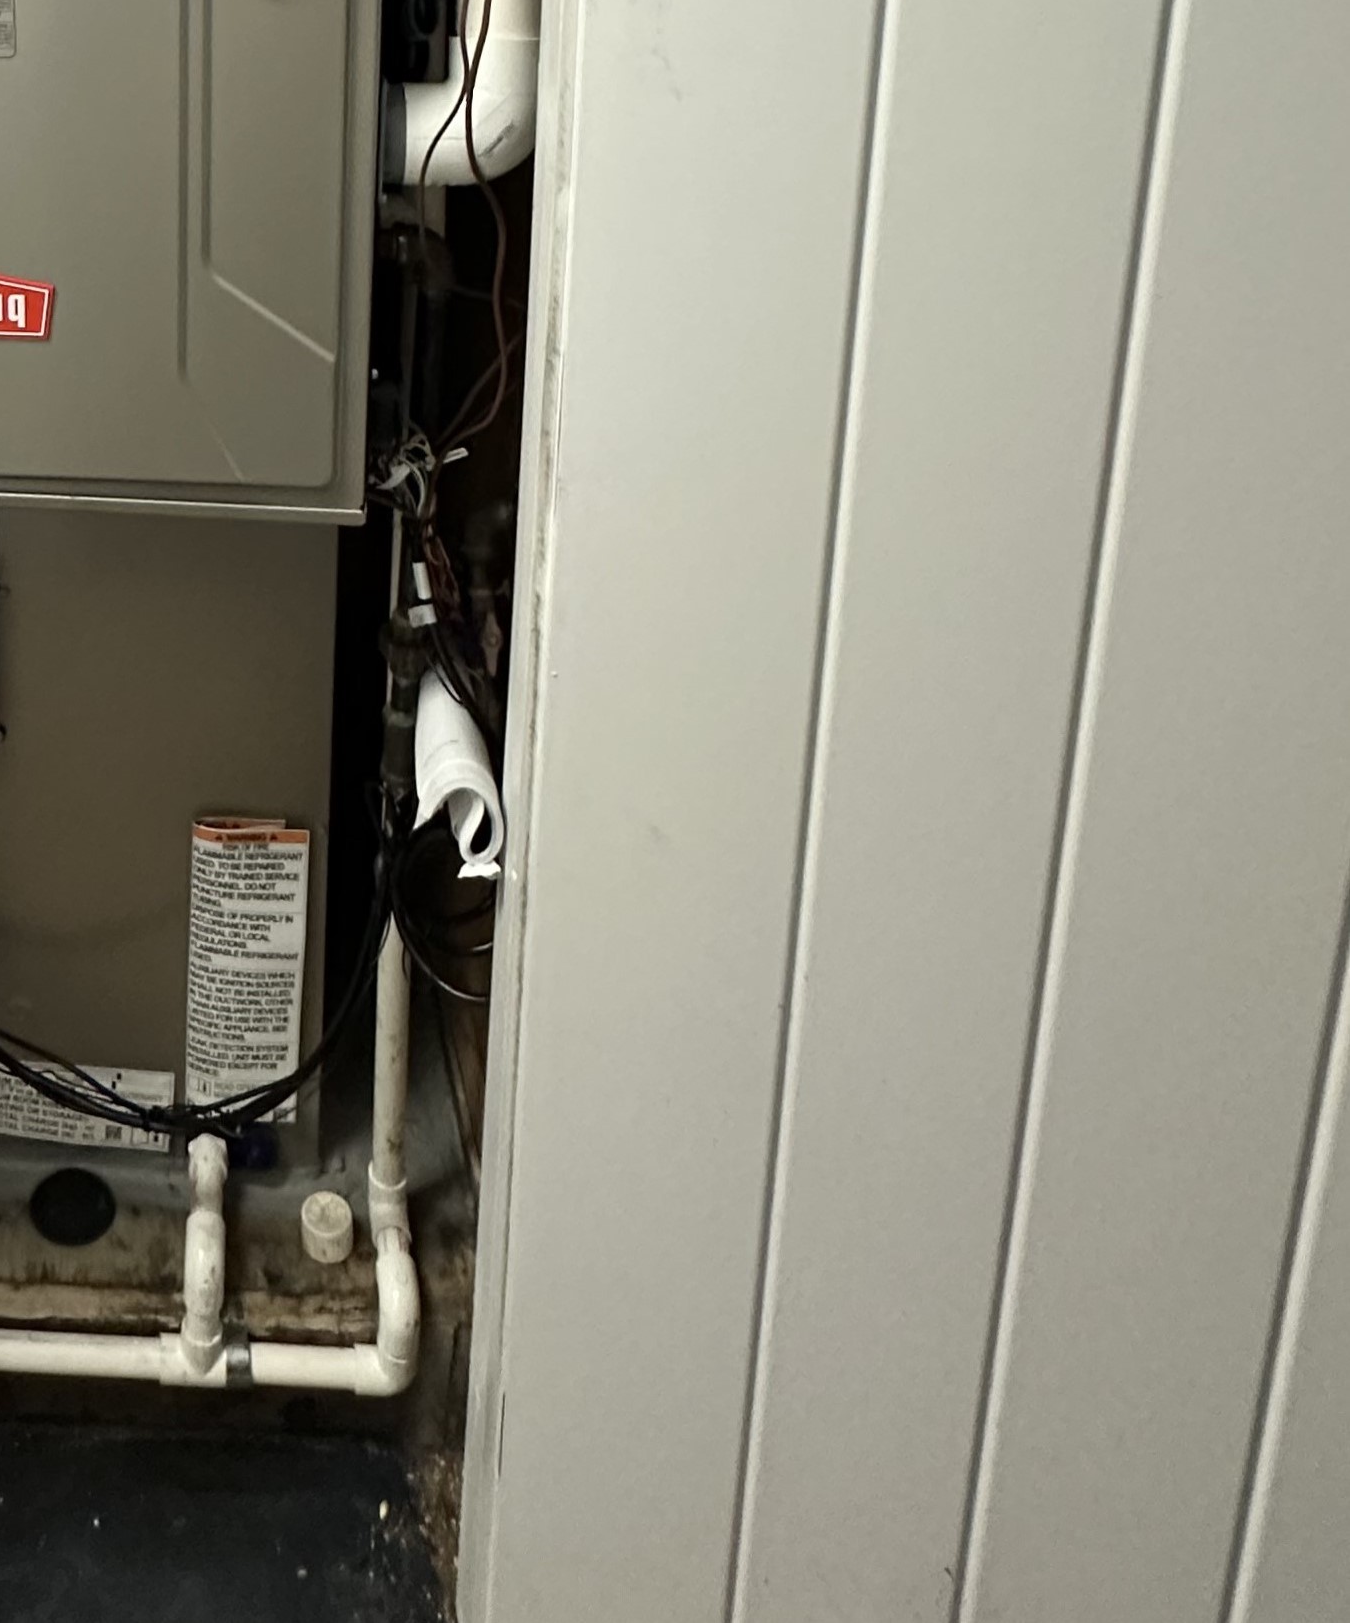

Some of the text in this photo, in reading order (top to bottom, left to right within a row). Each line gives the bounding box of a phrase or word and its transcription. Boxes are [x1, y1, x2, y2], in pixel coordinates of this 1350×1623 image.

[245, 853, 303, 861] REFRIGERANT
[243, 863, 285, 871] REPAIRED
[227, 872, 263, 881] TRAINED
[265, 873, 300, 881] SERVICE
[259, 882, 277, 891] NOT
[237, 892, 296, 901] REFRIGERANT
[243, 932, 271, 942] LOCAL
[241, 950, 299, 960] REFRIGERANT
